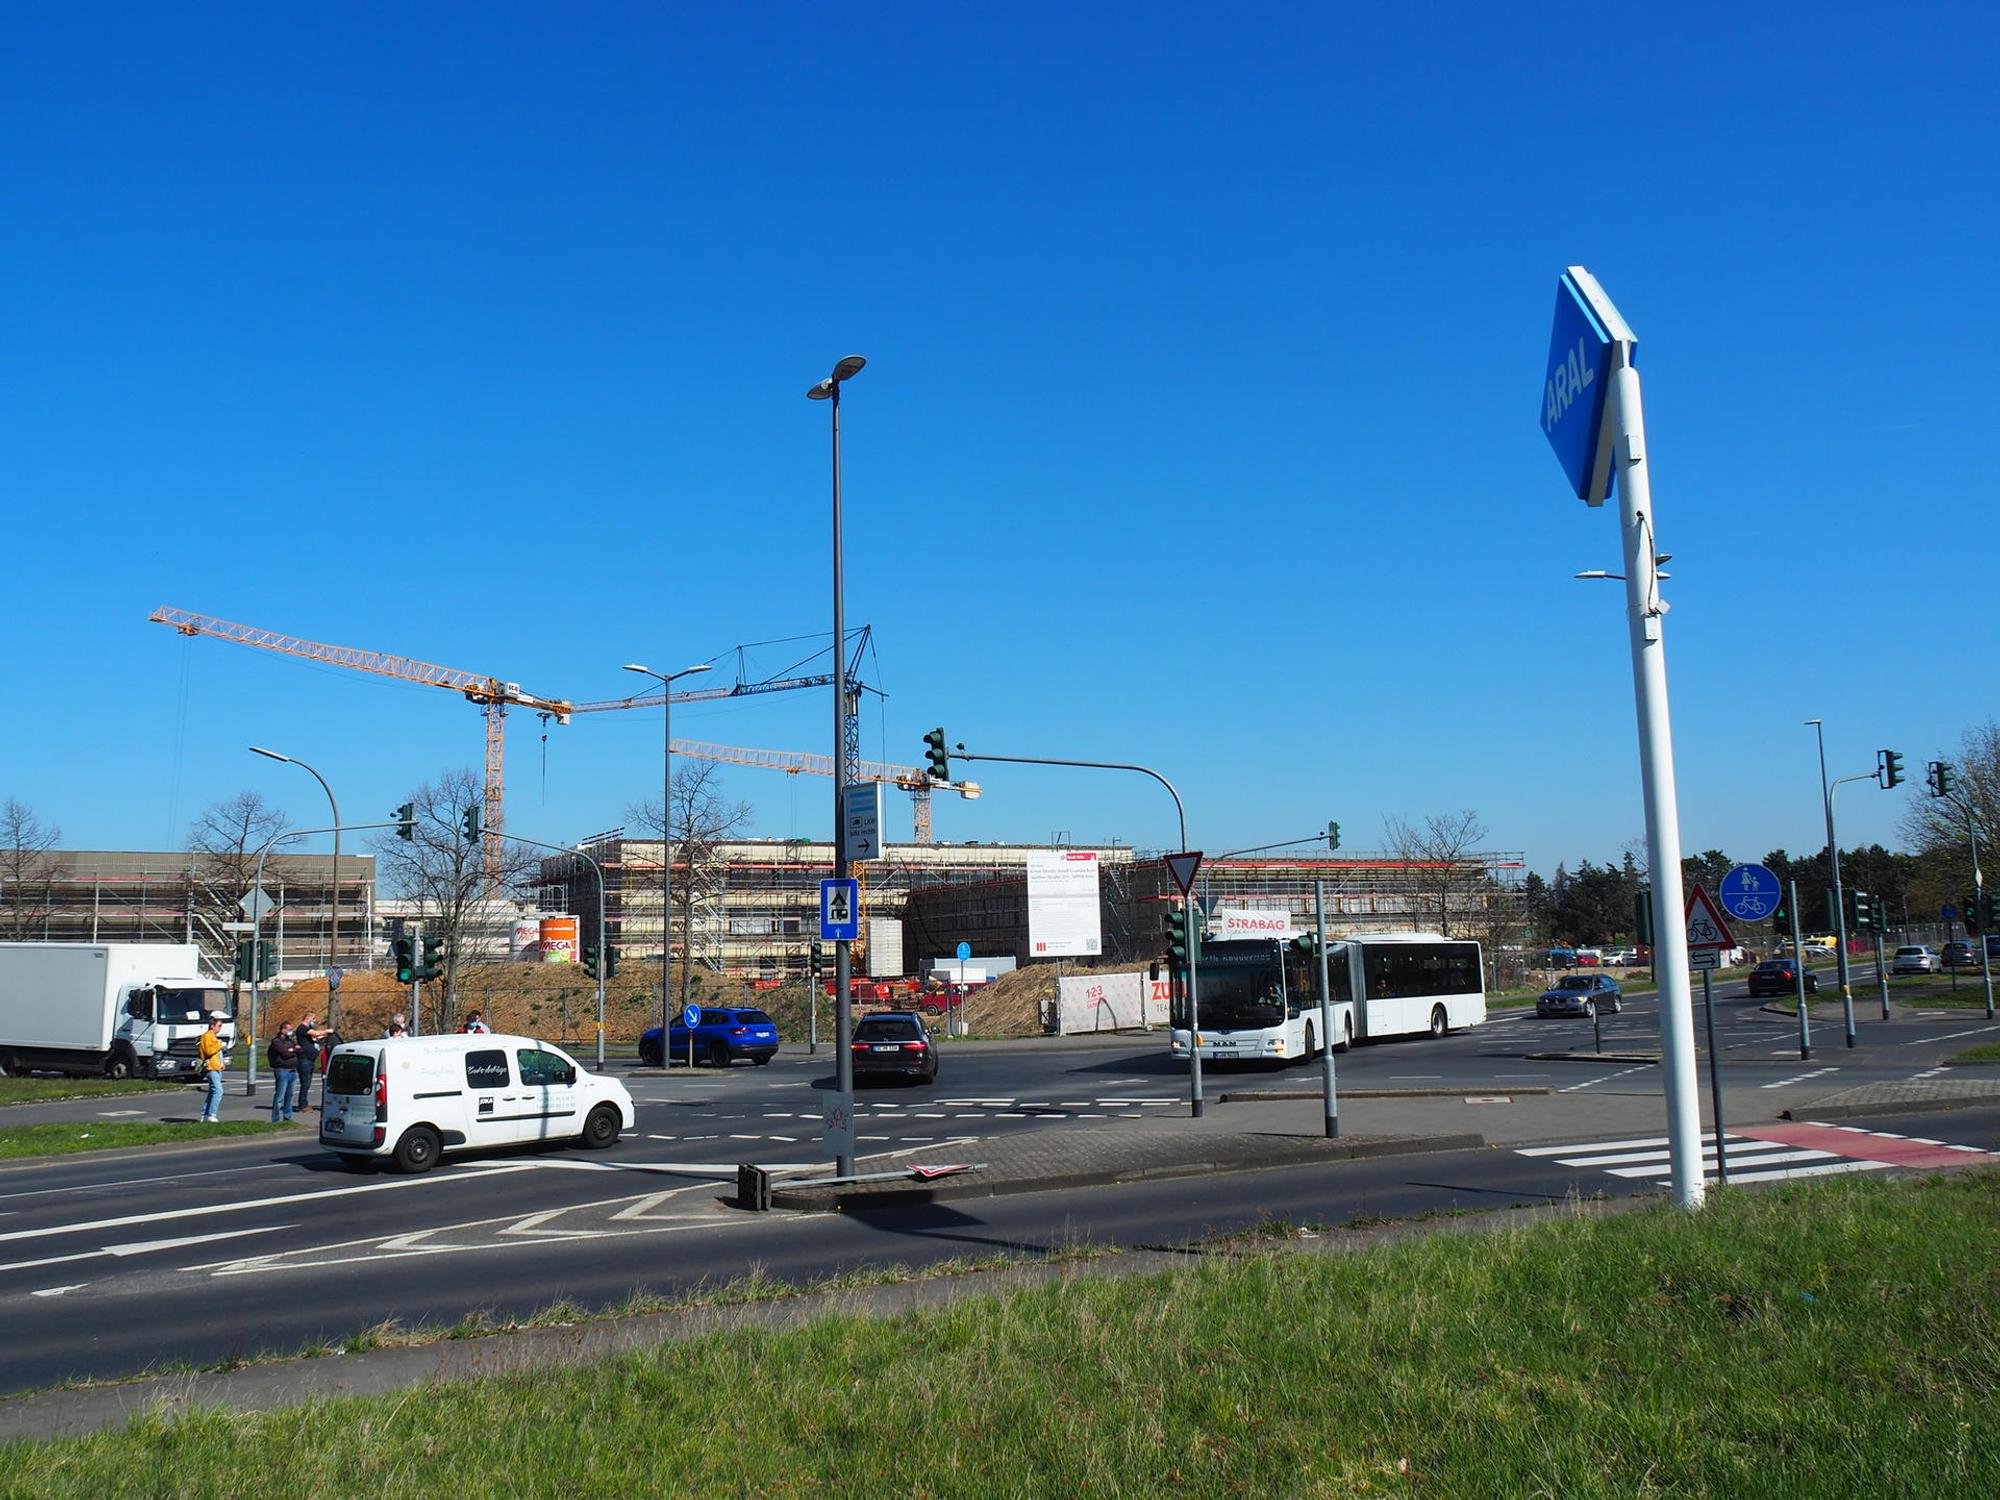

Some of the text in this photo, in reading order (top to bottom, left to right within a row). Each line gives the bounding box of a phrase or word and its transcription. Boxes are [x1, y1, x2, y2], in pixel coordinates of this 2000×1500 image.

[1547, 336, 1594, 433] ARAL
[1227, 918, 1285, 930] STRABAG
[542, 941, 571, 951] MEGA
